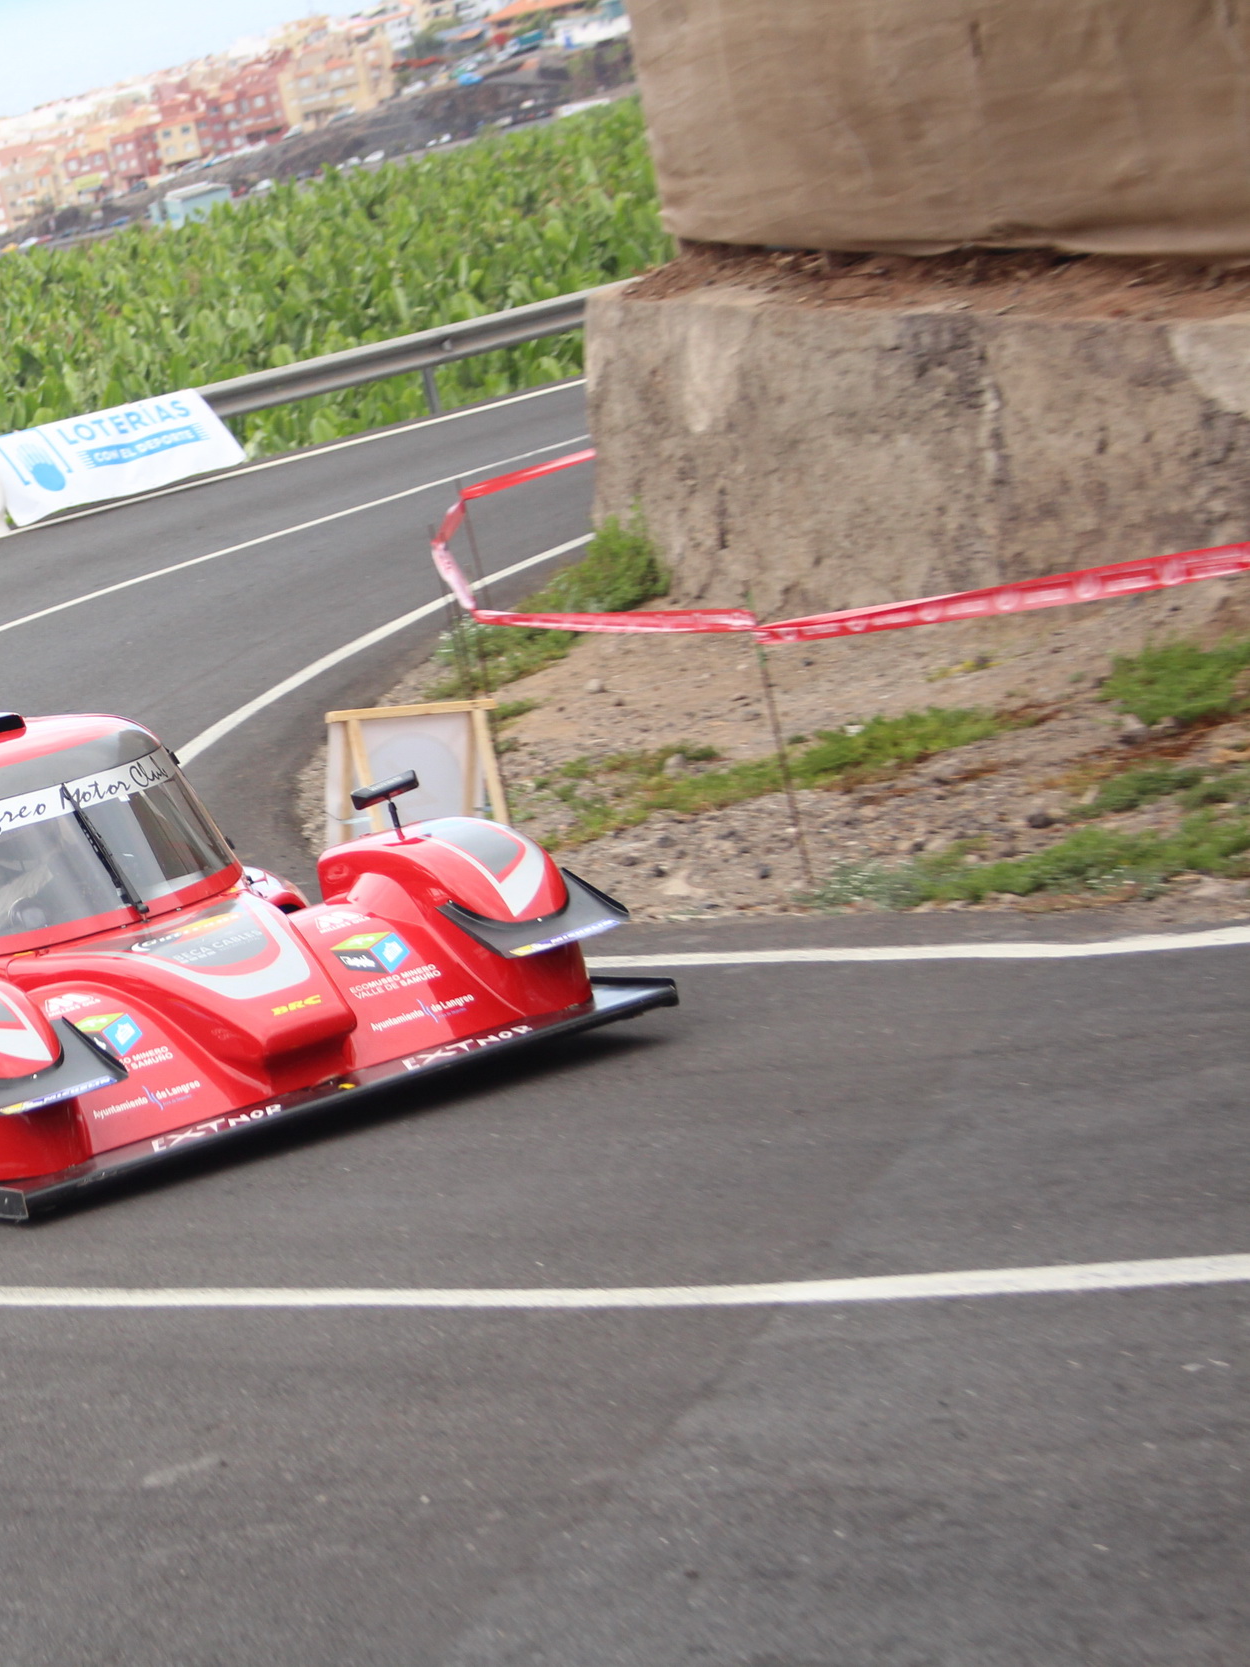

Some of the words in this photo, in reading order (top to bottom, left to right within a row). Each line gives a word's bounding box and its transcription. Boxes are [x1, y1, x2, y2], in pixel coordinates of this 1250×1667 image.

[93, 450, 120, 462] CON
[120, 447, 137, 459] EL
[136, 428, 195, 452] DEPORTE
[59, 780, 130, 810] Motor
[172, 944, 212, 961] BECA
[211, 929, 263, 949] CABLES
[349, 973, 401, 994] ECOMUSEO
[400, 963, 437, 979] MINERO
[353, 985, 385, 1000] VALLE
[385, 981, 400, 992] DE
[270, 994, 322, 1016] BRC
[370, 1009, 425, 1032] Ayuntamiento
[430, 1002, 442, 1012] de
[440, 994, 475, 1009] Langreo
[132, 1045, 169, 1062] MINERO
[401, 1025, 534, 1071] EXTNOR
[93, 1095, 149, 1119] Ayuntamiento
[155, 1089, 167, 1100] de
[166, 1080, 201, 1096] Langreo
[151, 1103, 282, 1153] EXTNOR
